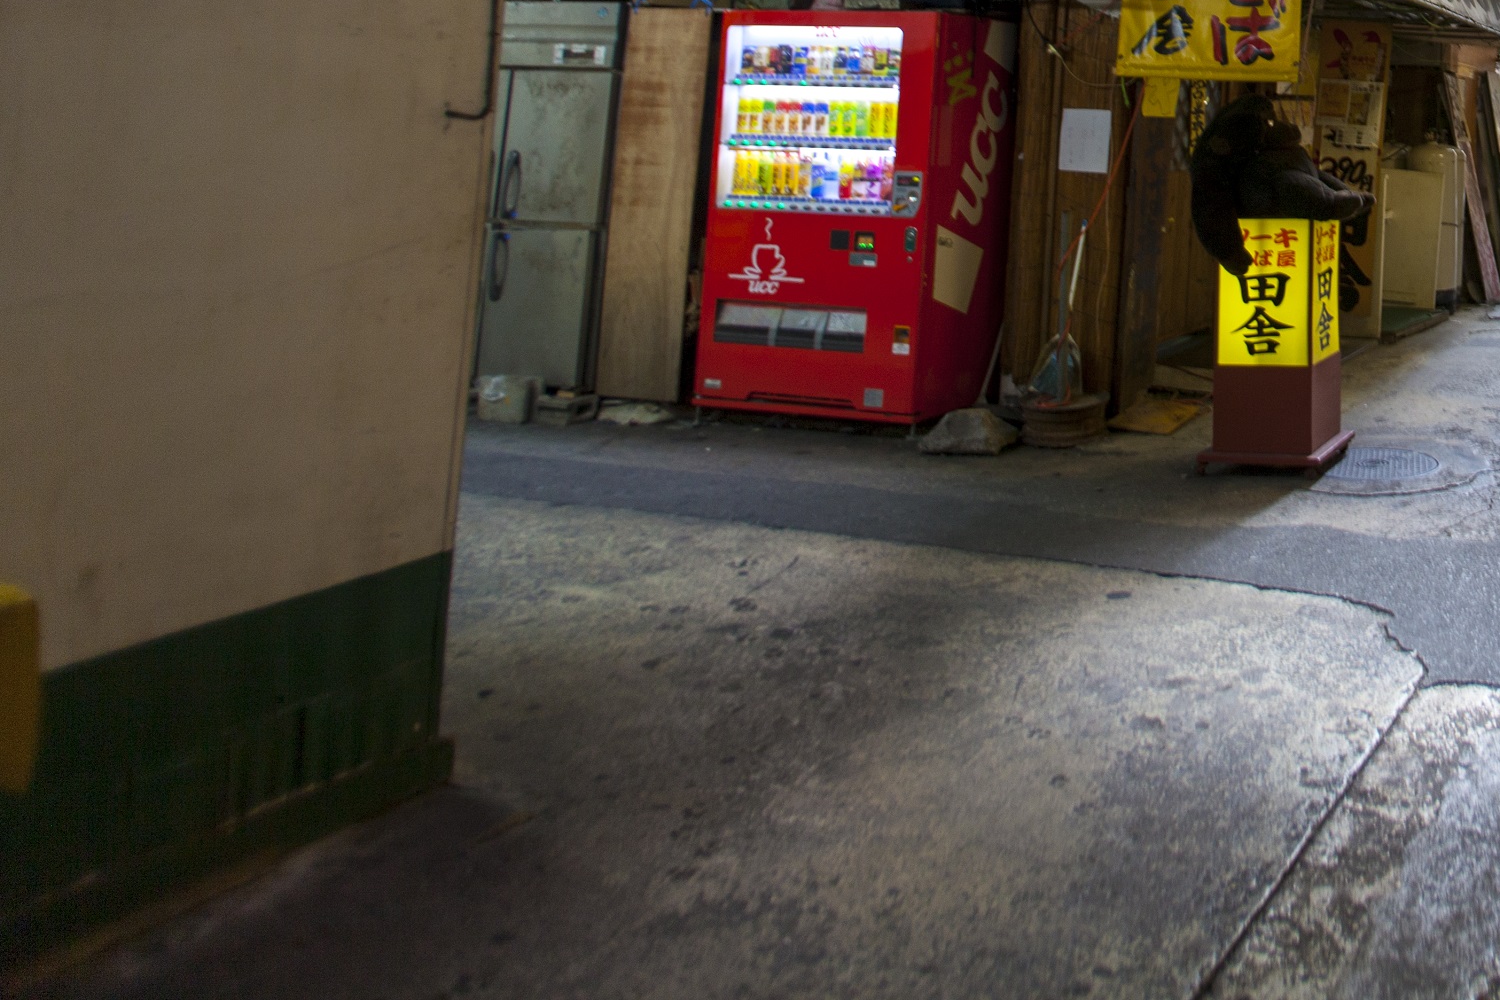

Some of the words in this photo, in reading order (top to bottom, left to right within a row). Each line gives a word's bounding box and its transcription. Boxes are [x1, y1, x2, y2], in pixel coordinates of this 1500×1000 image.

[1252, 250, 1296, 267] ば屋
[1230, 271, 1296, 356] 田舎
[1316, 266, 1334, 352] 田舎
